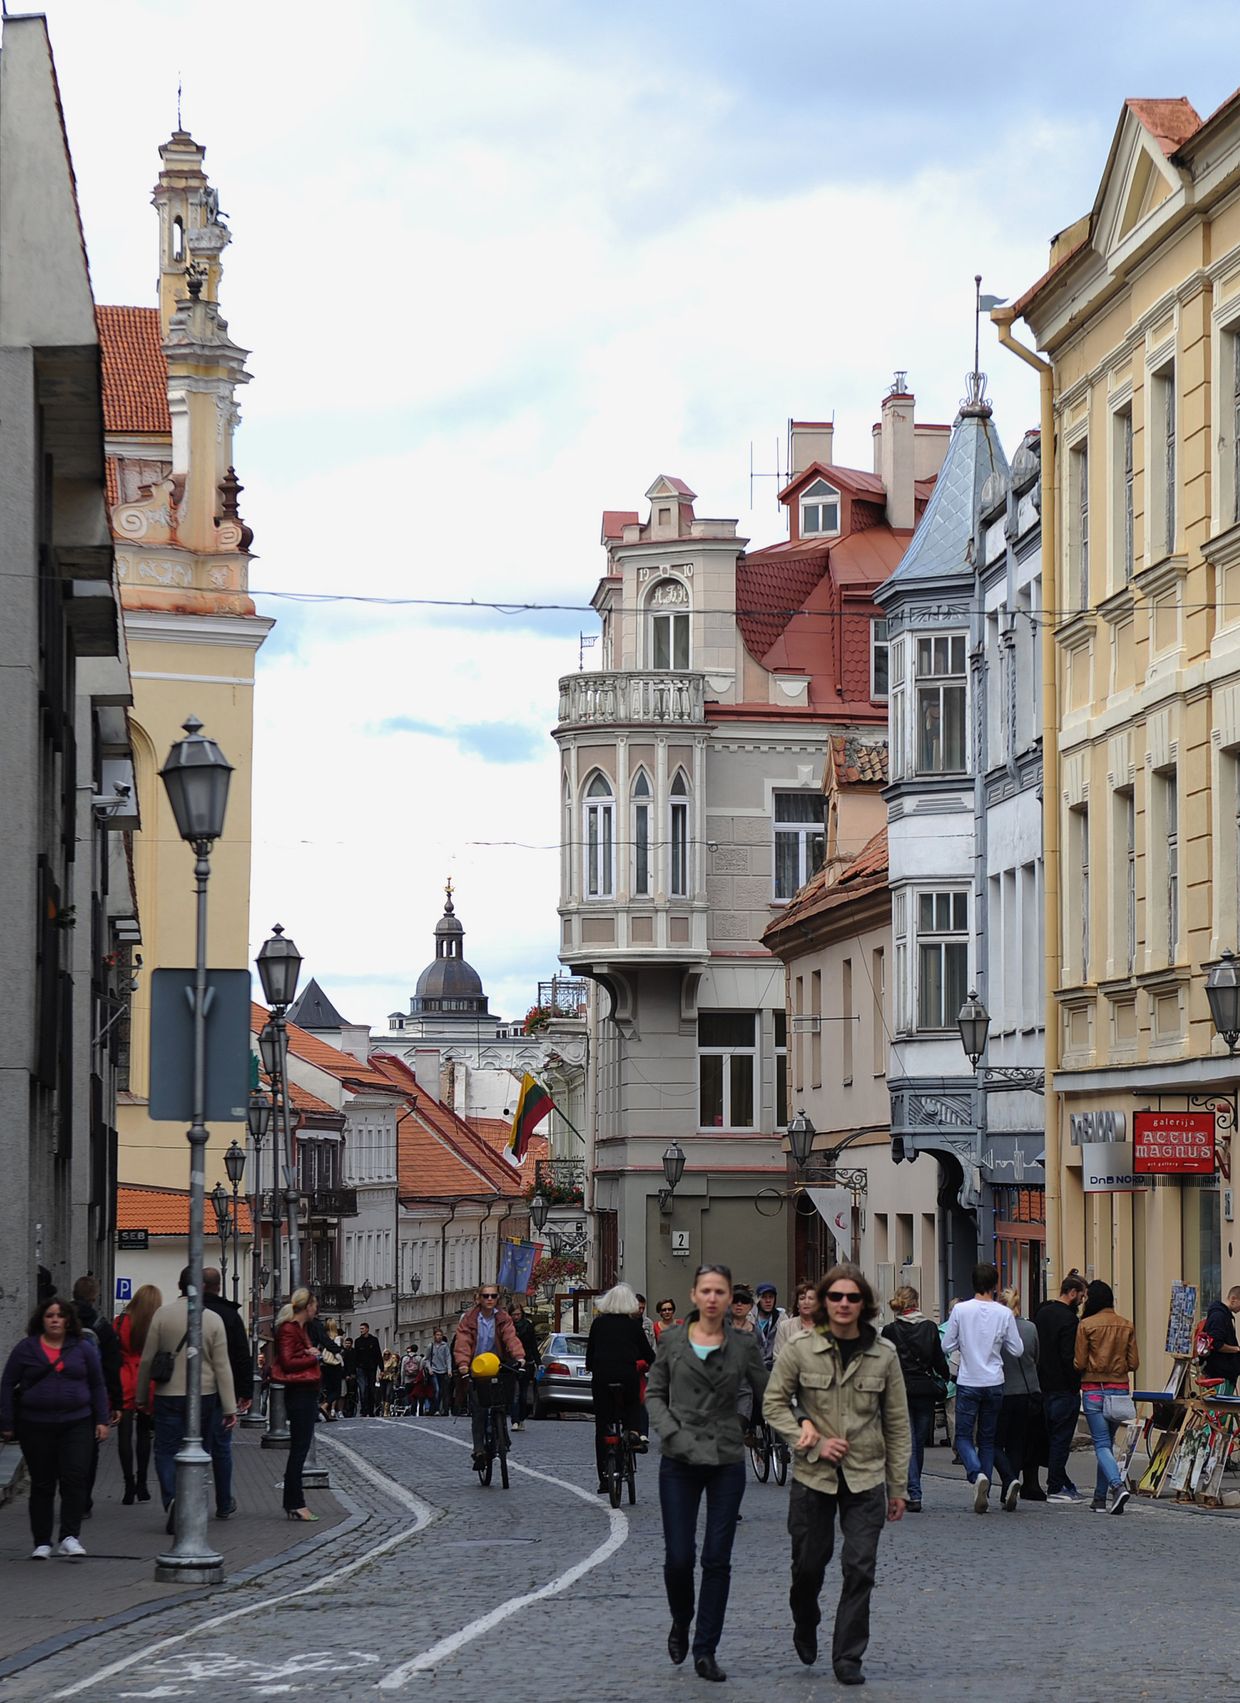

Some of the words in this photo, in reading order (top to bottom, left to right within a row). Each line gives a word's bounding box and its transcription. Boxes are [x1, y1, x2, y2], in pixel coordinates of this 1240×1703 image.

[1153, 1118, 1195, 1127] galerija
[1143, 1131, 1206, 1144] ACTUS
[1136, 1145, 1211, 1158] MAGNUS
[1090, 1176, 1115, 1185] DnB
[1116, 1175, 1145, 1184] NORD
[121, 1232, 145, 1240] SEB
[679, 1233, 684, 1246] 2
[120, 1280, 129, 1298] P
